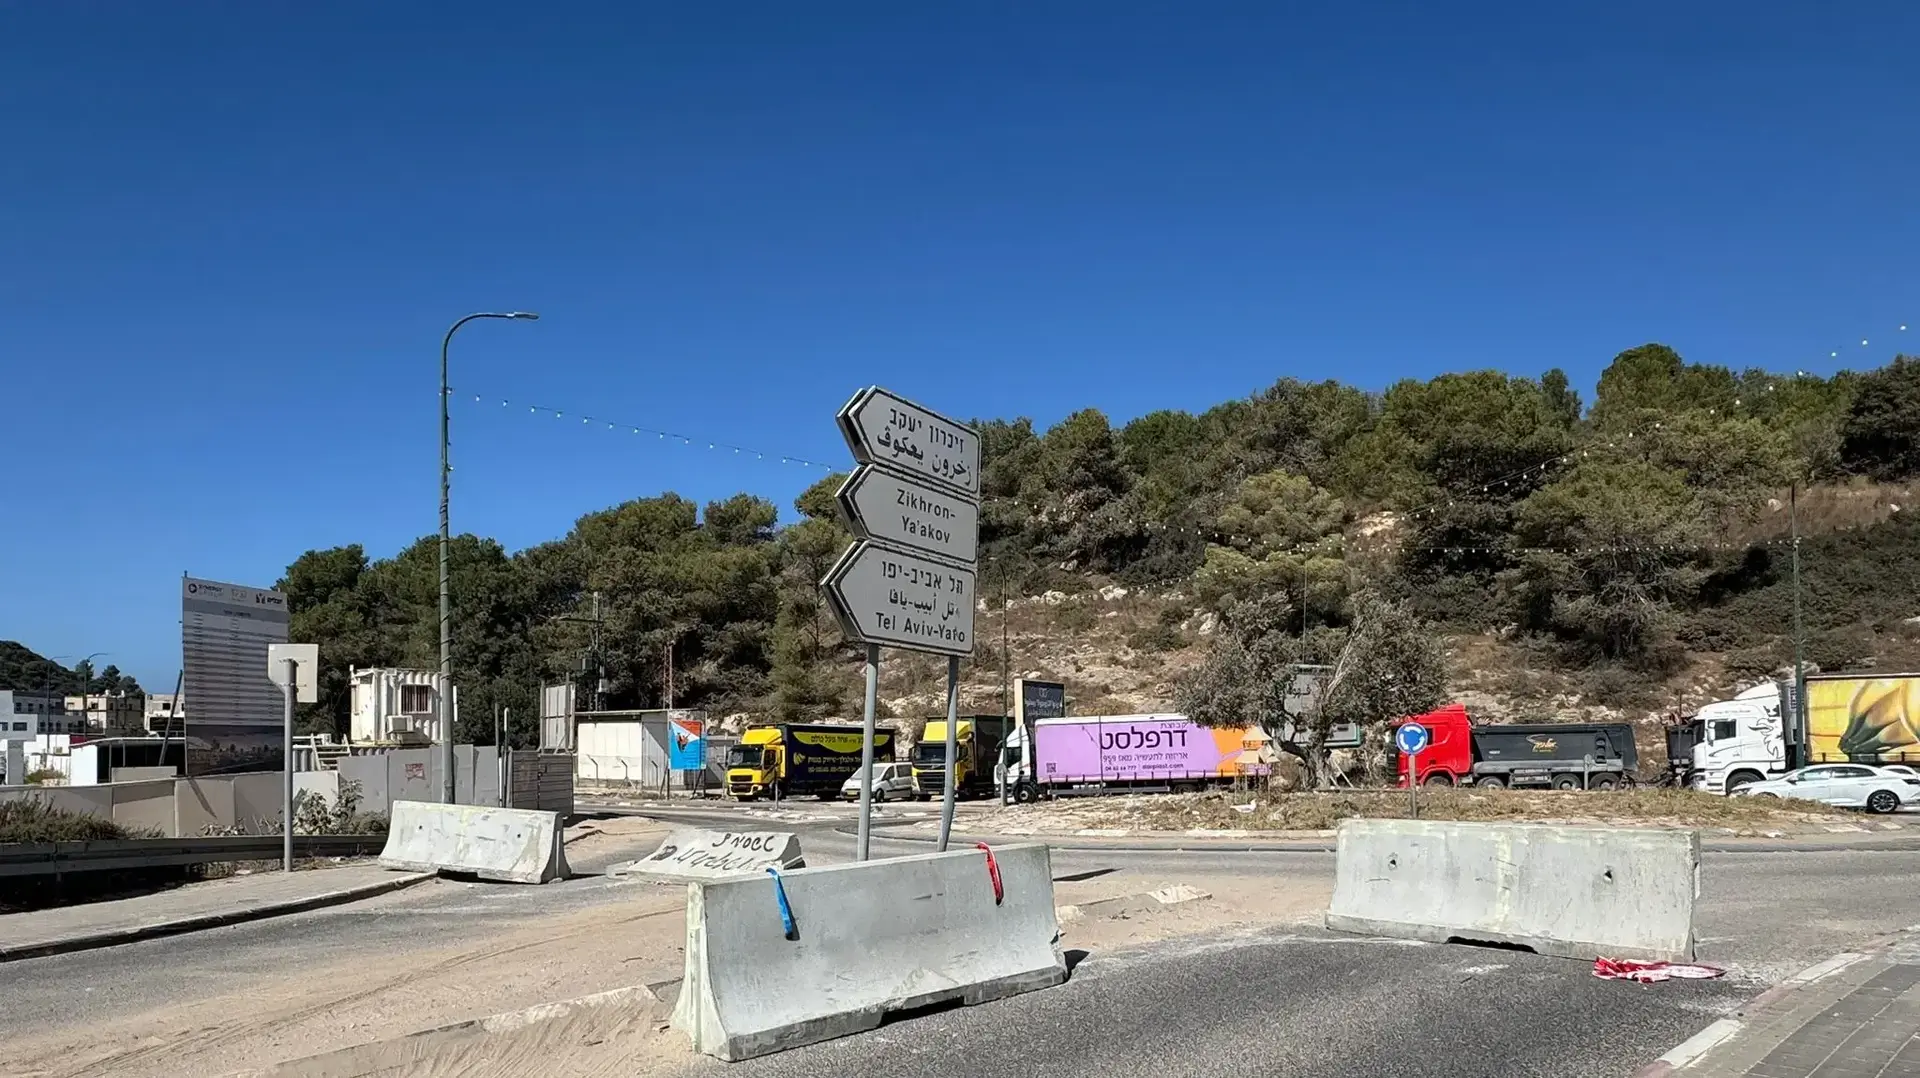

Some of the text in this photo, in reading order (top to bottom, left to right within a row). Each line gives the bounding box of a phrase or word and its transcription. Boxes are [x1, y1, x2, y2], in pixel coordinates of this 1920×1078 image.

[889, 408, 964, 453] זיכרון יעקב
[932, 454, 971, 486] زخرون
[897, 488, 956, 519] Zikhron-
[901, 515, 950, 543] Ya'akov
[882, 561, 942, 589] אביב-יפו
[876, 612, 965, 642] Tel Aviv-Yafo
[1101, 725, 1188, 750] דרפלסט
